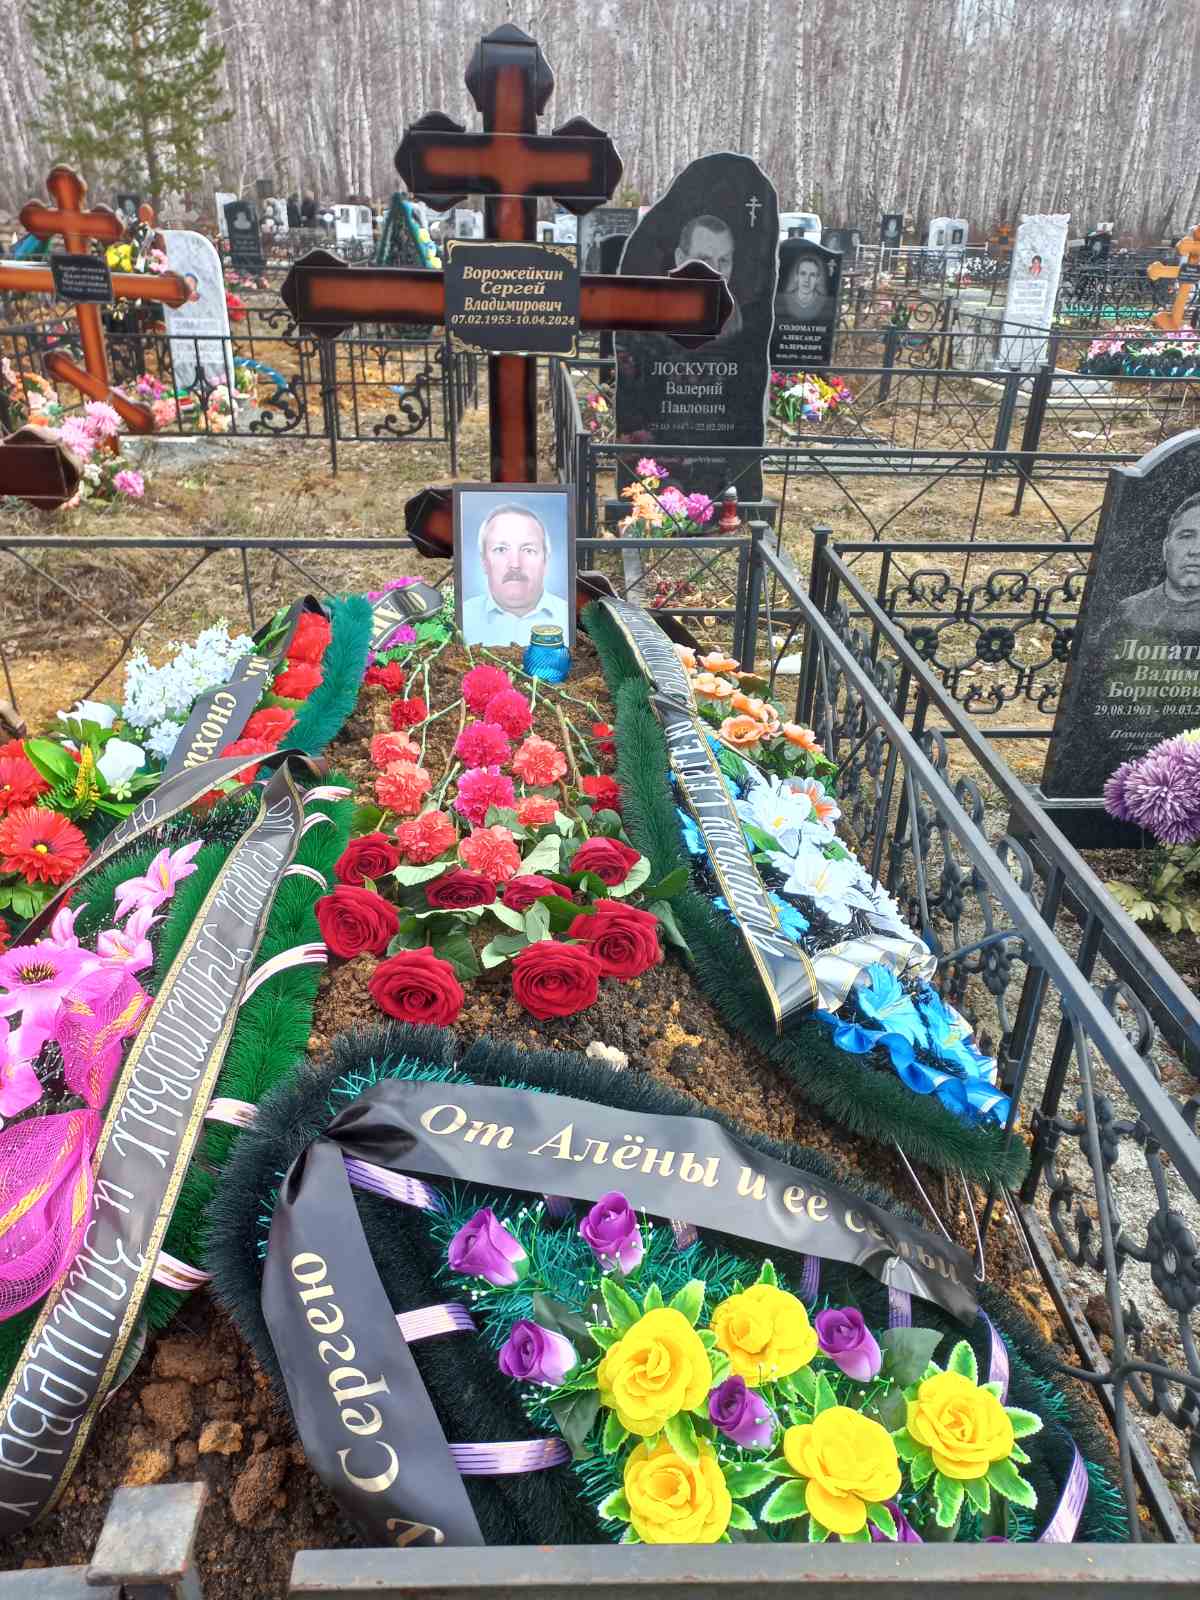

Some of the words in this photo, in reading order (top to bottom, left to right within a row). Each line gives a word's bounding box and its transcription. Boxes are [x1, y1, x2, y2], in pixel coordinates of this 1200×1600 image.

[462, 266, 564, 282] Ворожейкин
[480, 281, 546, 297] Сергей
[463, 297, 562, 314] Владимирович
[450, 315, 577, 325] 07.02.1953-10.04.2024
[650, 362, 739, 376] ЛОСКУТОВ
[665, 381, 723, 398] Валерий
[660, 401, 726, 415] Павлович
[1133, 666, 1199, 683] Вадим
[1093, 705, 1152, 716] 29.08.1961
[256, 795, 296, 833] от
[214, 840, 284, 927] семьи
[419, 1103, 516, 1150] От
[527, 1121, 720, 1188] Алёны
[736, 1166, 768, 1201] и
[94, 1178, 136, 1214] и
[291, 1252, 400, 1493] Сергею
